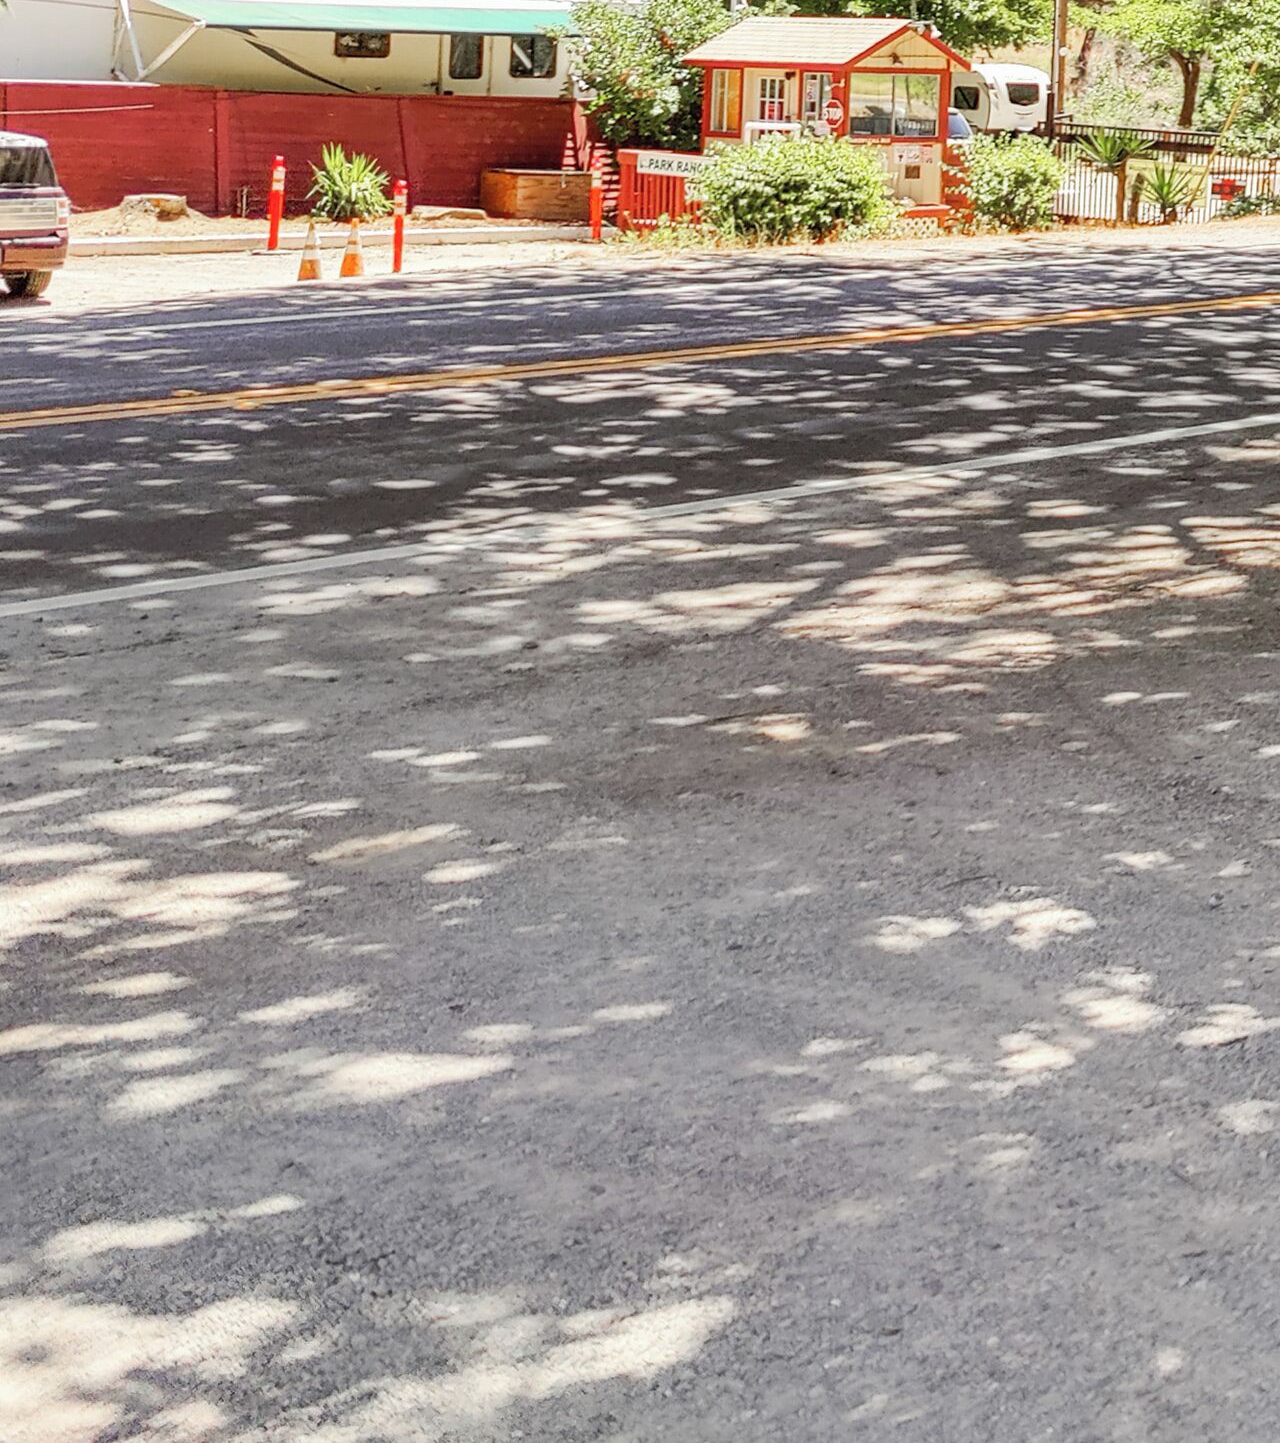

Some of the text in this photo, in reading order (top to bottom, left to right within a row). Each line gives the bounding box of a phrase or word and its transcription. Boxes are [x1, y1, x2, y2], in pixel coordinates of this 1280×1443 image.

[822, 107, 842, 121] STOP
[648, 158, 706, 175] PARK RANG
